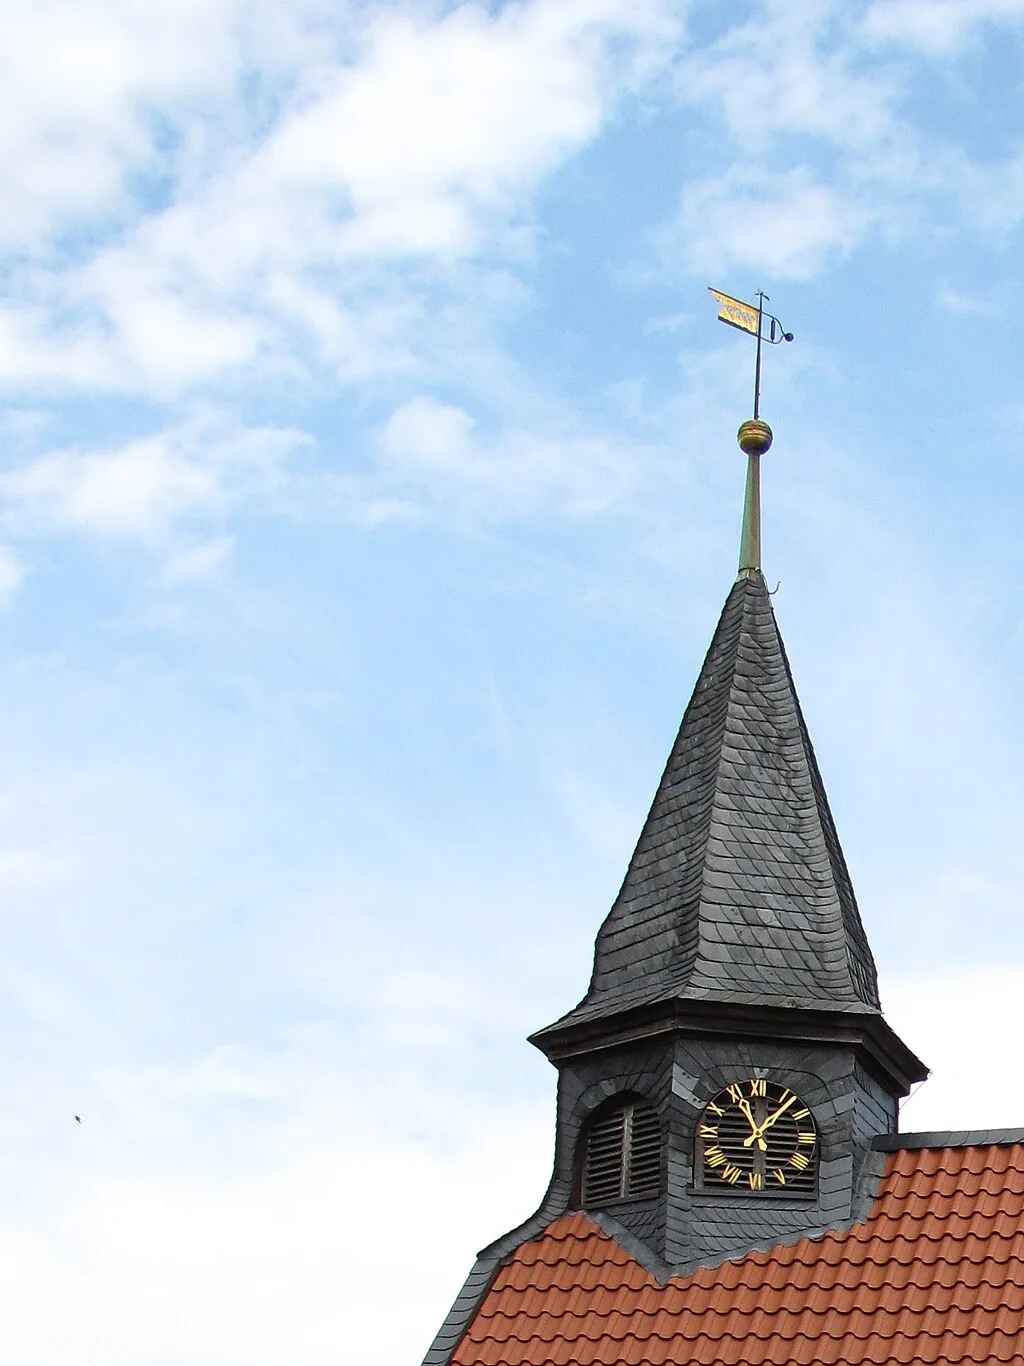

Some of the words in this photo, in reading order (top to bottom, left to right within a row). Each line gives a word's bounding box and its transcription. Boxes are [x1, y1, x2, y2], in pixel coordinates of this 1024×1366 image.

[726, 1083, 744, 1103] XI
[750, 1079, 767, 1097] XII
[707, 1101, 726, 1117] X
[699, 1124, 719, 1138] IX
[773, 1168, 787, 1185] V
